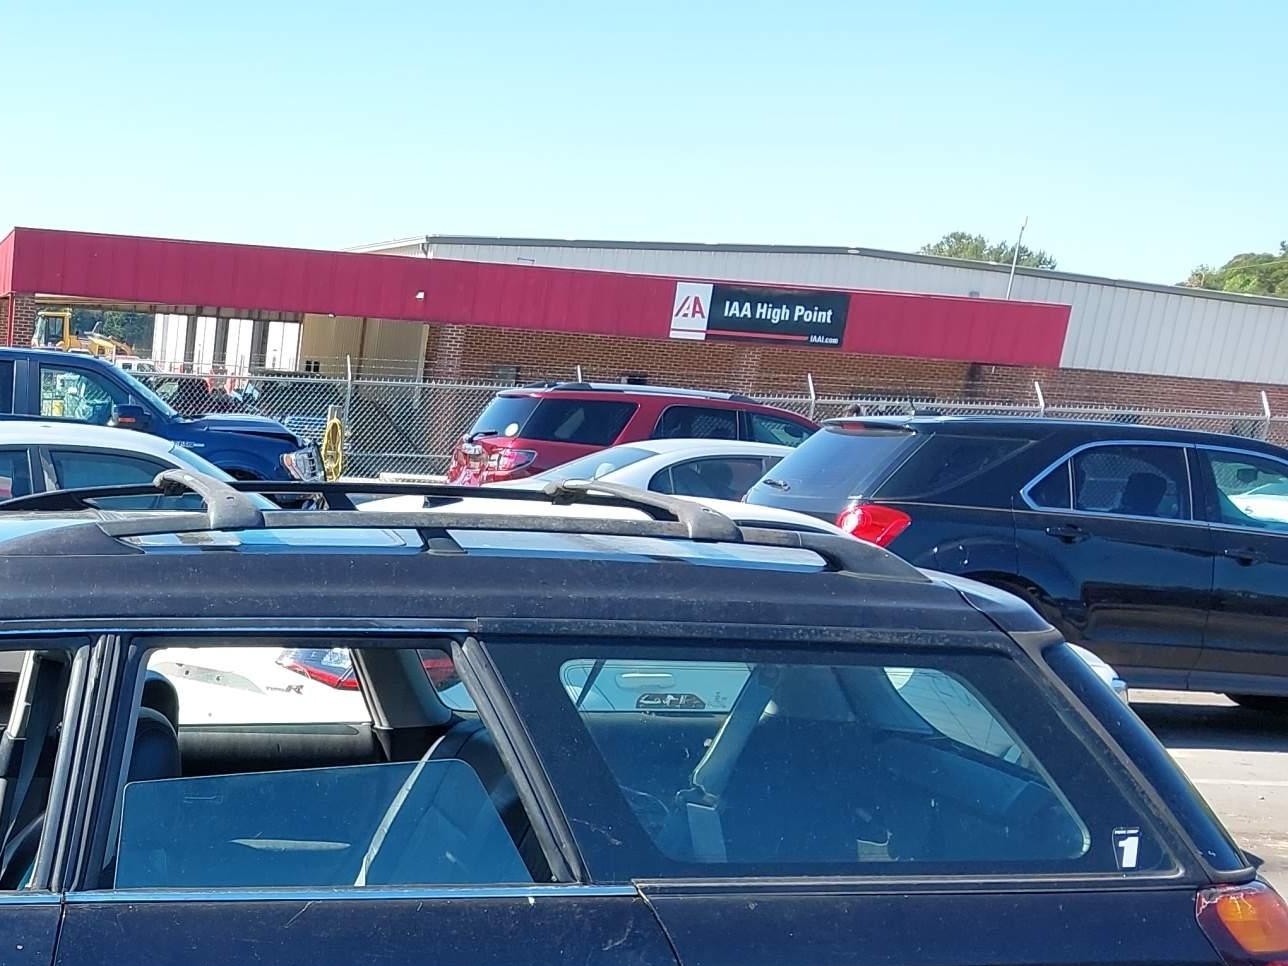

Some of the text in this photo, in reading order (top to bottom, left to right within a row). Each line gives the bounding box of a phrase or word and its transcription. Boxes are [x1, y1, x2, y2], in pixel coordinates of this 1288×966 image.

[723, 300, 834, 324] IAA High Point
[1118, 836, 1139, 868] 1
